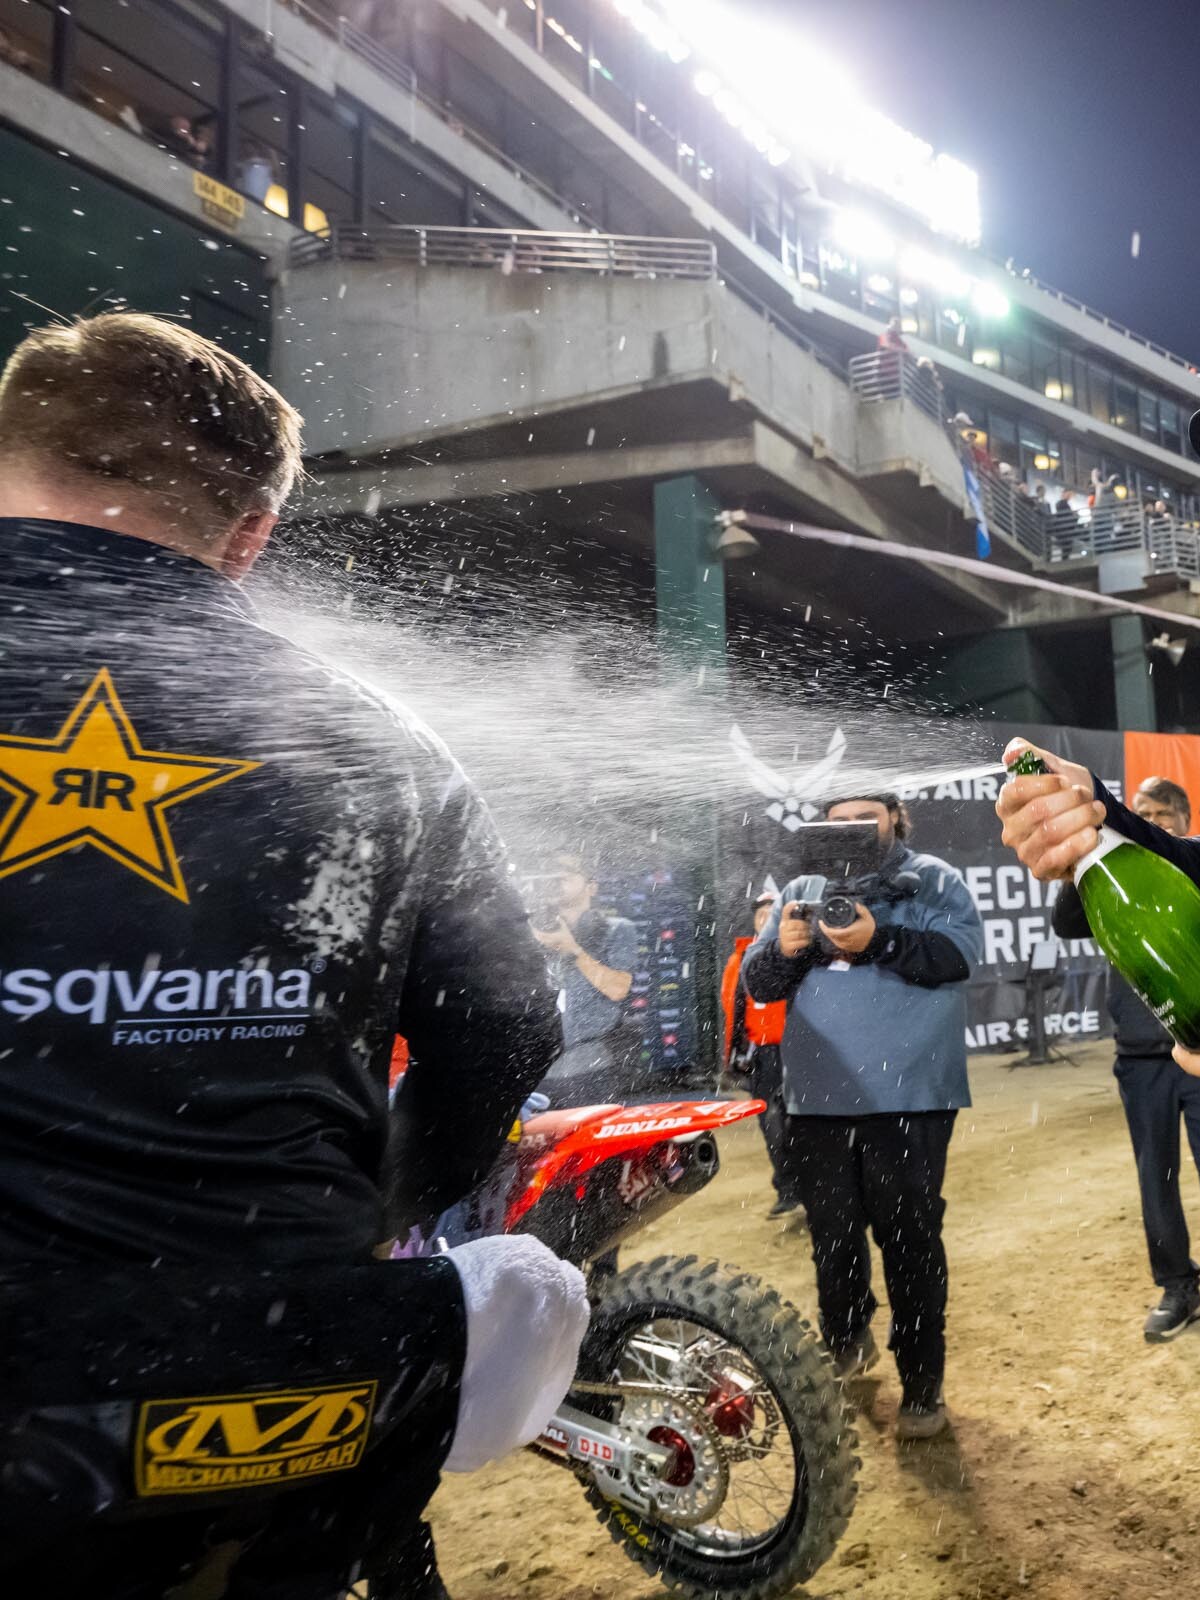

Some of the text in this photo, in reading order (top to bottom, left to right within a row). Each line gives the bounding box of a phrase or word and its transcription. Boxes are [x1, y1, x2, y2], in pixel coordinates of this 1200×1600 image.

[0, 968, 311, 1025] sqvarna
[112, 1022, 307, 1046] FACTORY RACING
[593, 1116, 693, 1140] DUNLOP
[146, 1441, 358, 1489] MECHANIX WEAR
